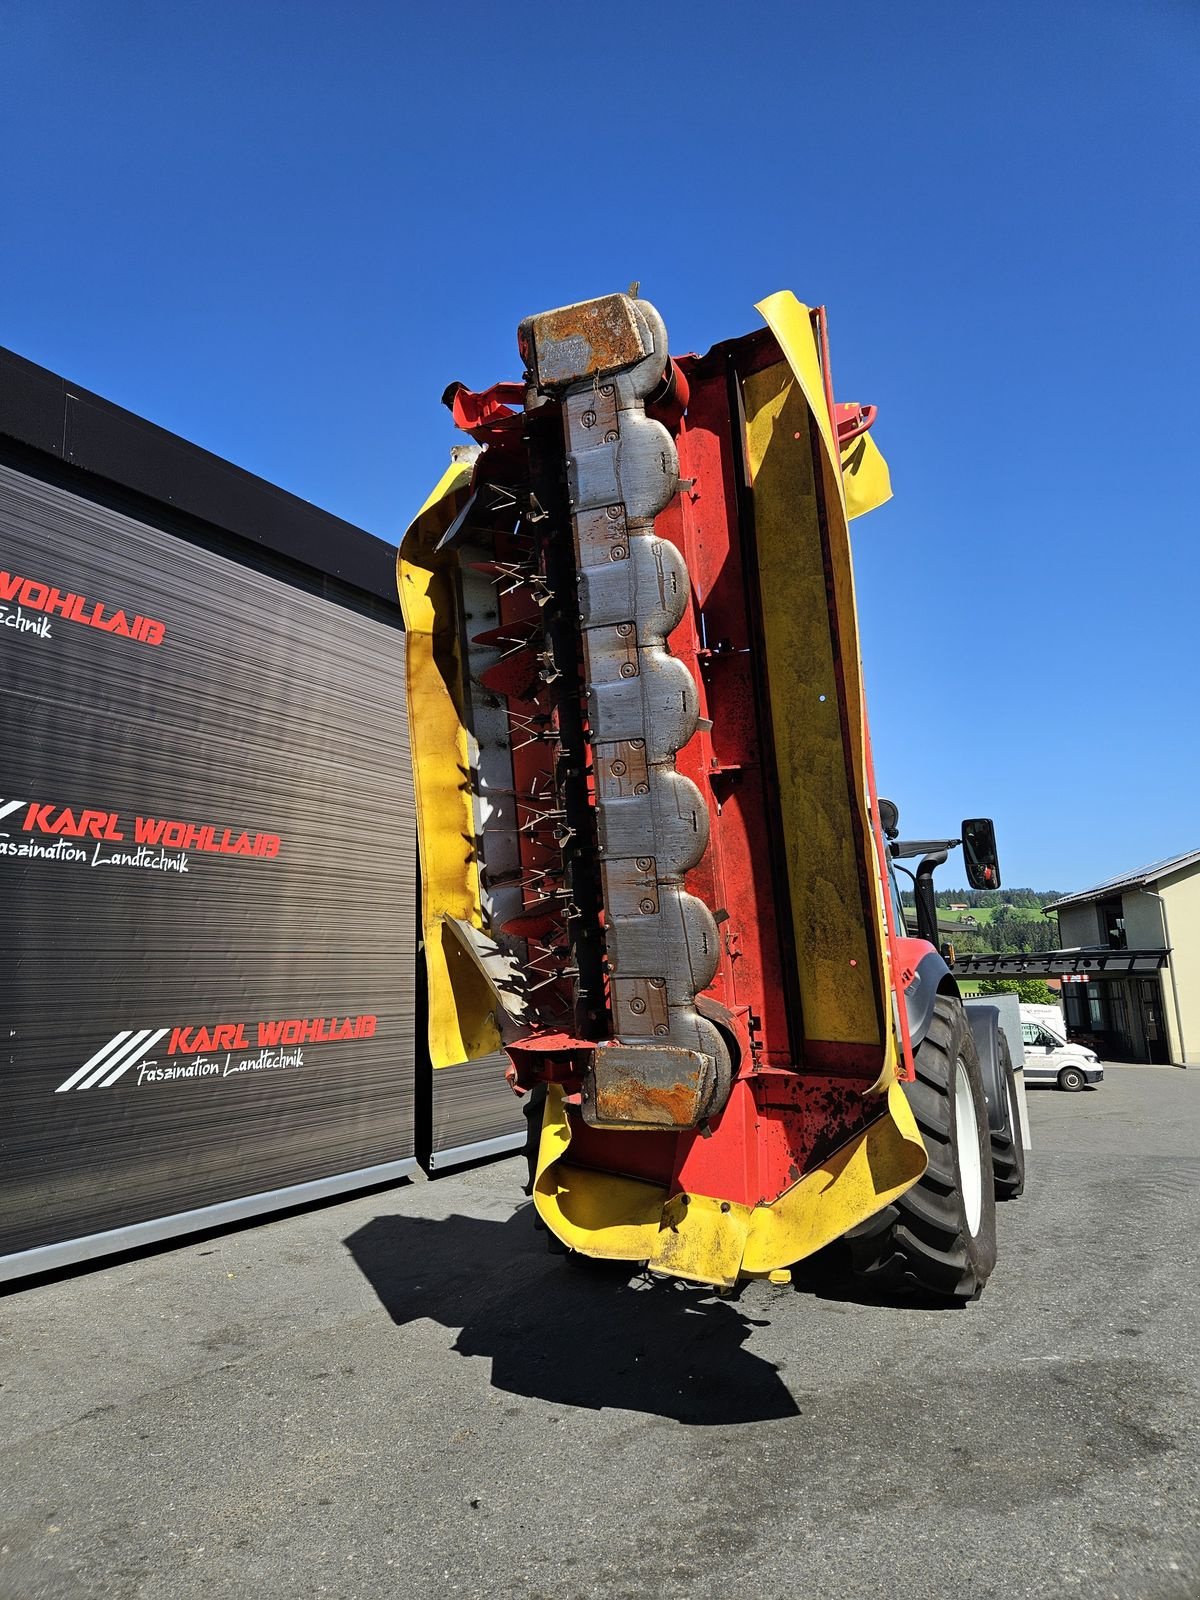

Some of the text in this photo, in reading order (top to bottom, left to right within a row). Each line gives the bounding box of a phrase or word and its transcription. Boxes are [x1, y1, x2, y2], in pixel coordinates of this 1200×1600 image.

[22, 802, 281, 858] KARL WOHLLAIB
[0, 833, 189, 873] aszination Landtechnik
[167, 1015, 377, 1055] KARL WOHLLAIB
[137, 1047, 303, 1086] Faszination Landtechnik
